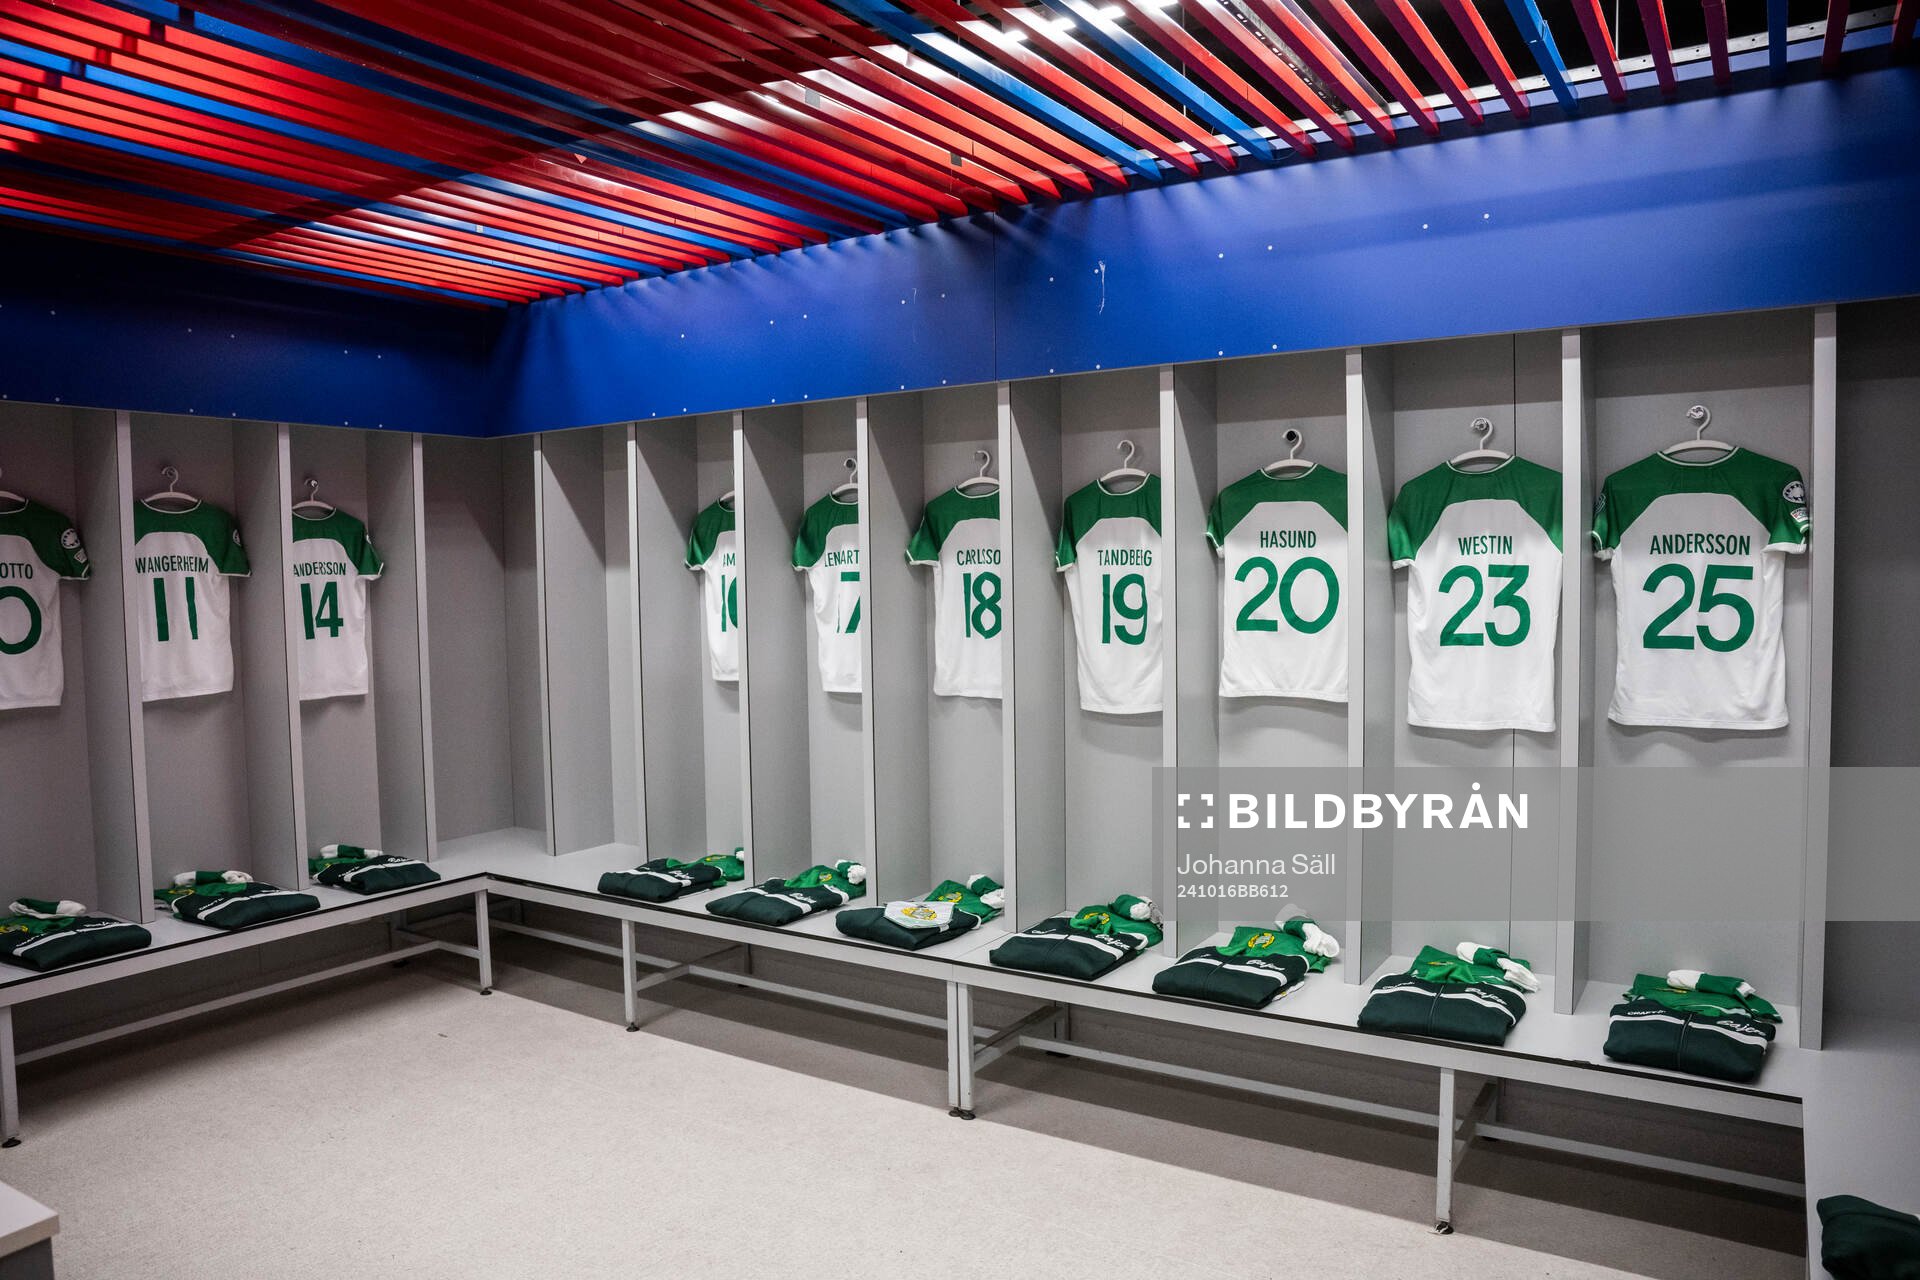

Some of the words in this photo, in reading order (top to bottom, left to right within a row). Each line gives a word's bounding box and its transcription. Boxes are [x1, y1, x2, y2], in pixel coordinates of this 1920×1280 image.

[135, 555, 209, 574] WANGERHEIM
[1260, 530, 1317, 549] HASUND
[1458, 535, 1513, 556] WESTIN
[1650, 533, 1751, 556] ANDERSSON
[153, 576, 199, 642] 11
[300, 581, 344, 640] 14
[962, 571, 1002, 639] 18
[1101, 573, 1148, 645] 19
[1234, 556, 1340, 635] 20
[1438, 564, 1531, 647] 23
[1642, 563, 1755, 652] 25
